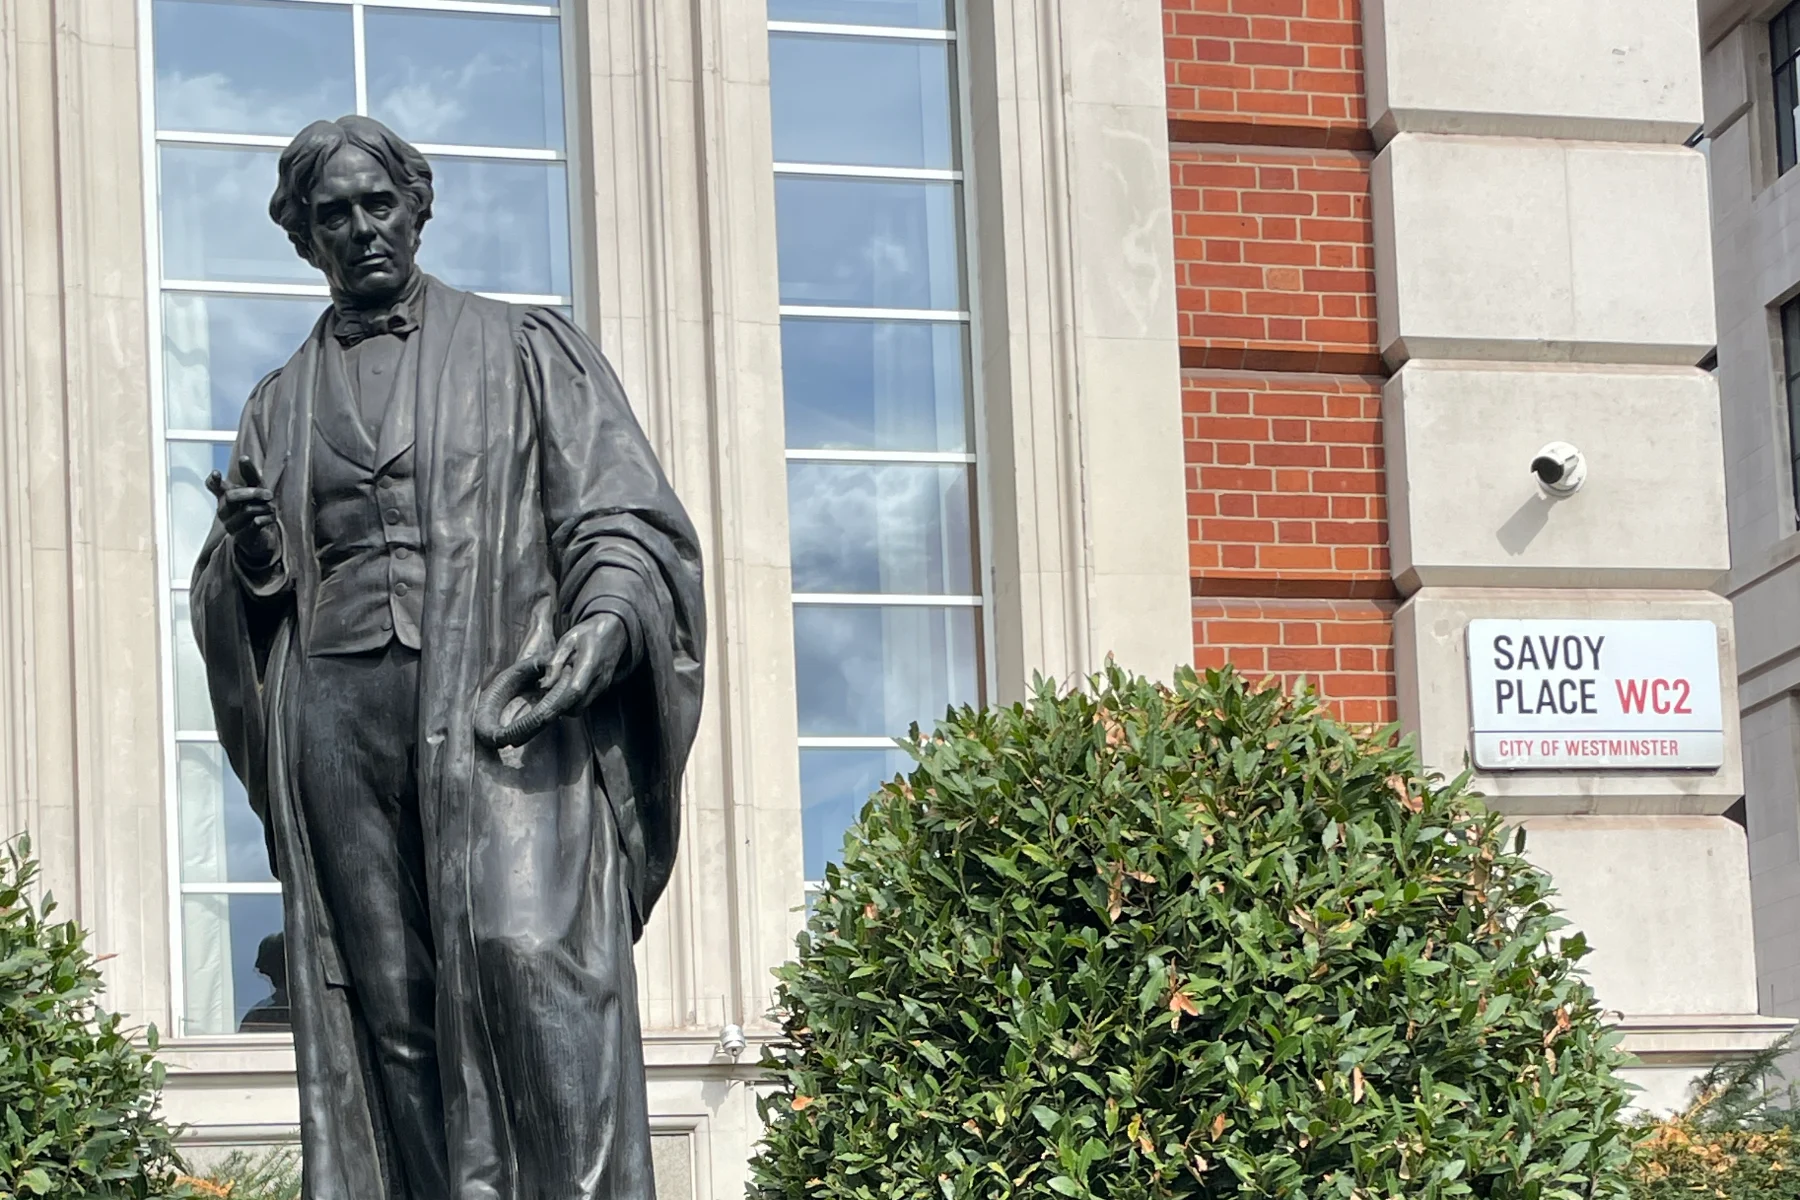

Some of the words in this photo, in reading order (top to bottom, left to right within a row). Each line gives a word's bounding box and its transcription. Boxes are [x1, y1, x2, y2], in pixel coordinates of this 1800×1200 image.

[1493, 634, 1605, 671] SAVOY
[1495, 678, 1598, 715] PLACE
[1615, 678, 1692, 715] WC2
[1499, 740, 1535, 757] CITY
[1541, 740, 1560, 757] OF
[1565, 739, 1679, 757] WESTMINSTER
